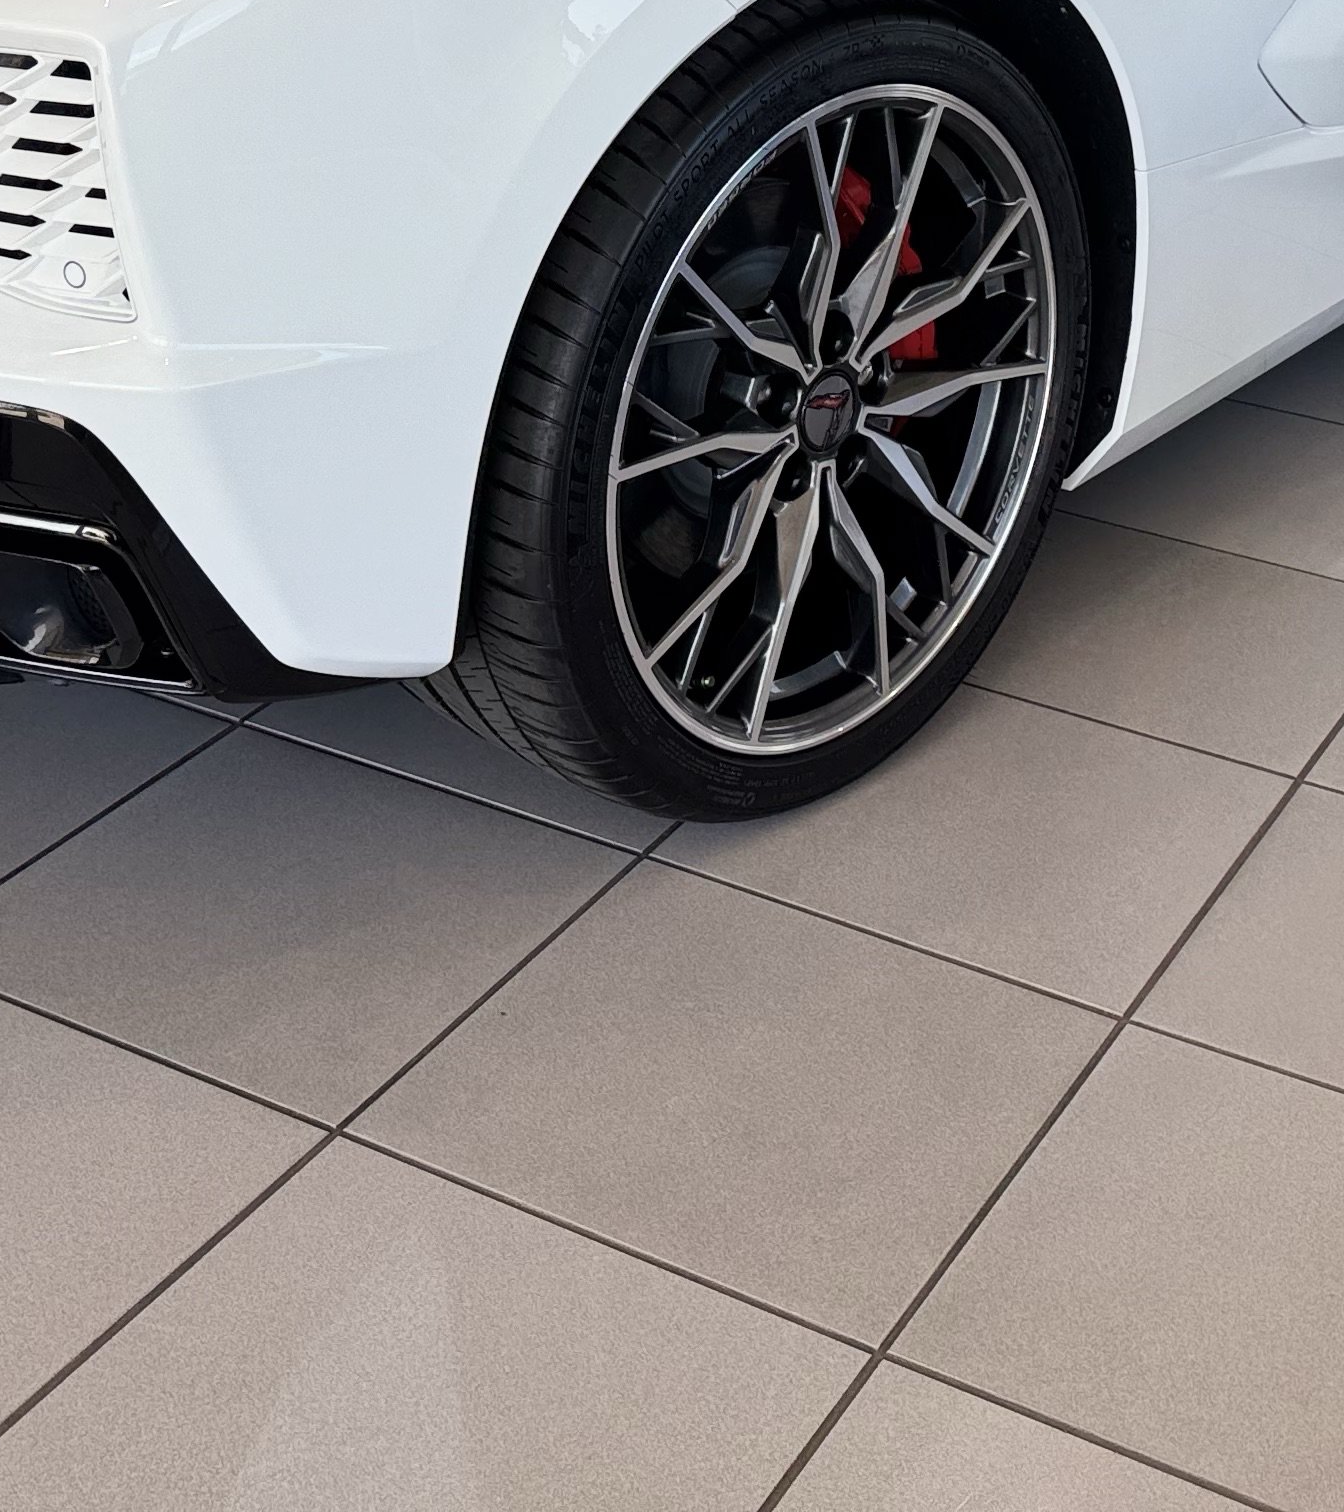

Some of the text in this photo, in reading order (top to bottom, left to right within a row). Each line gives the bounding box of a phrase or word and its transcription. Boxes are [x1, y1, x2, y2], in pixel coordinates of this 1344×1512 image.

[634, 209, 672, 273] PILOT
[673, 139, 720, 206] SPORT
[726, 108, 755, 139] ALL
[759, 58, 826, 109] SEASON
[993, 394, 1036, 525] CORVETTE
